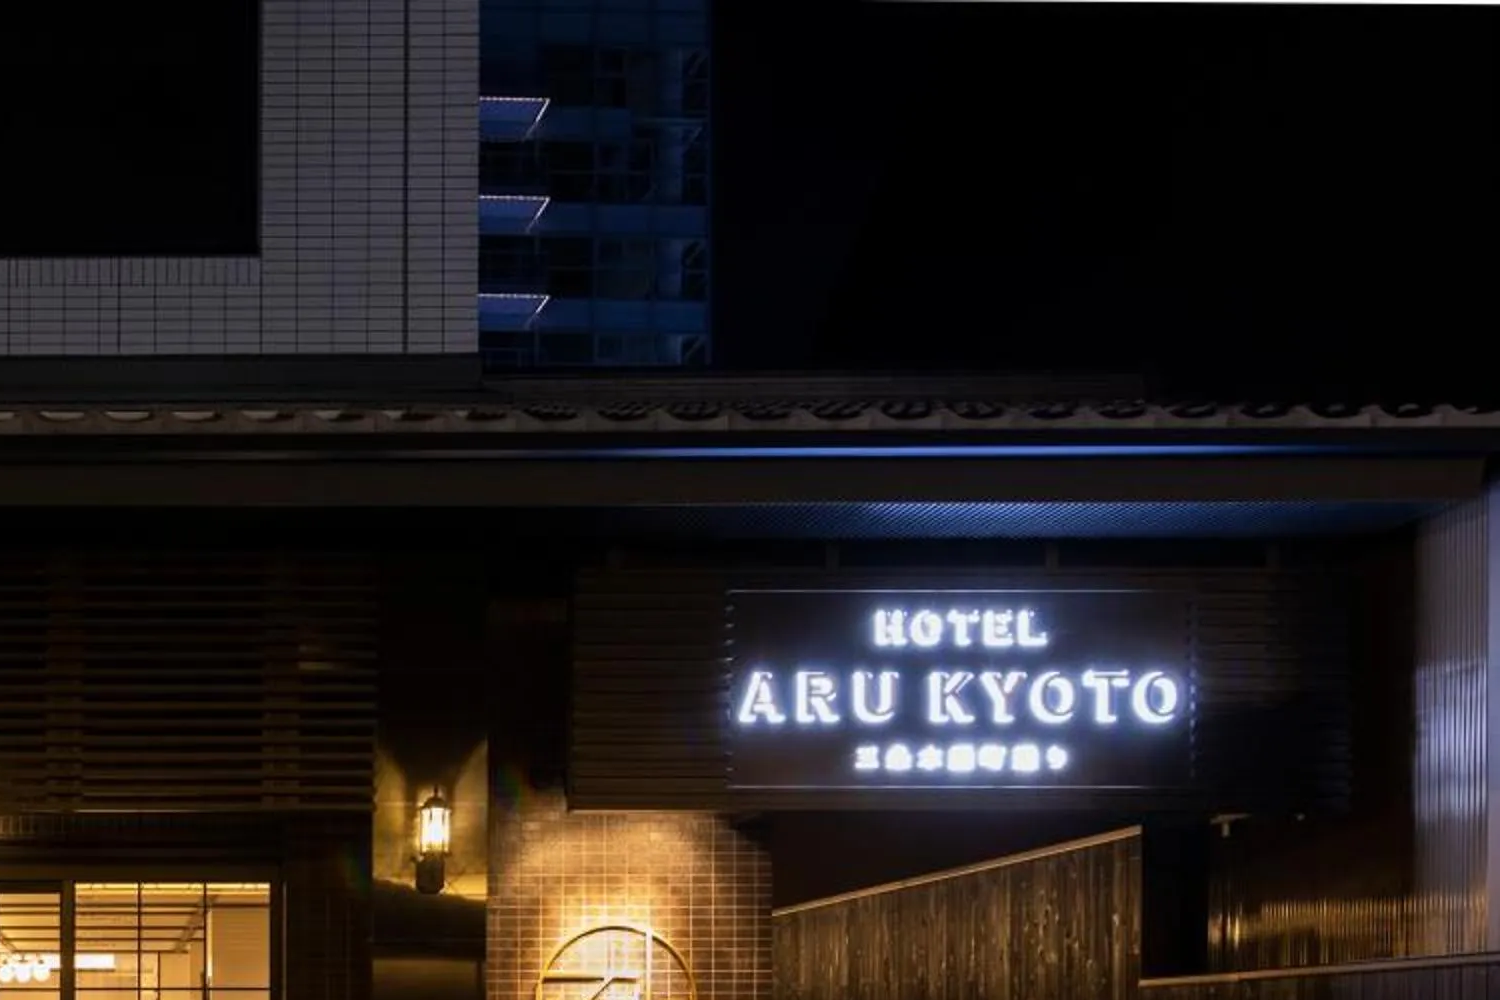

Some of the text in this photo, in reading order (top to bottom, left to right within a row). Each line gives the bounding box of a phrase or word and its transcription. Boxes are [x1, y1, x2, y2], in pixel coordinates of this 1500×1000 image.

[874, 609, 1048, 647] HOTEL
[738, 669, 1178, 724] ARU KYOTO
